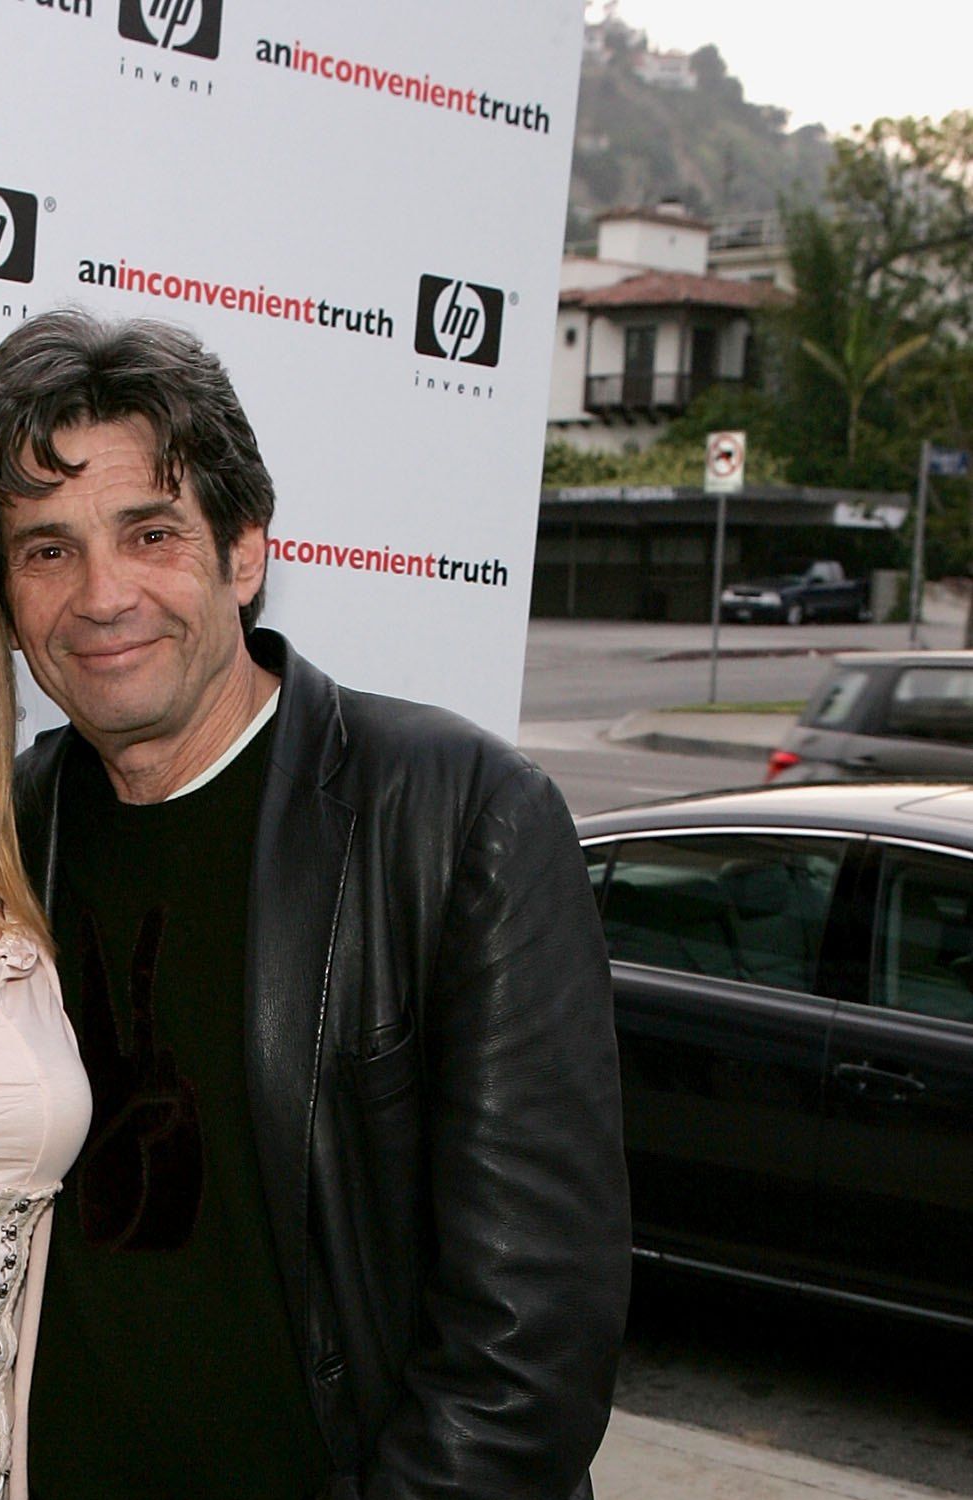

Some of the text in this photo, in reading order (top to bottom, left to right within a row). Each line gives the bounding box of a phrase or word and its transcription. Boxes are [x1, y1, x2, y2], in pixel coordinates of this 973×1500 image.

[120, 57, 212, 95] invent
[256, 39, 550, 134] aninconvenienttruth
[77, 259, 393, 339] aninconvenienttruth
[415, 370, 493, 398] invent
